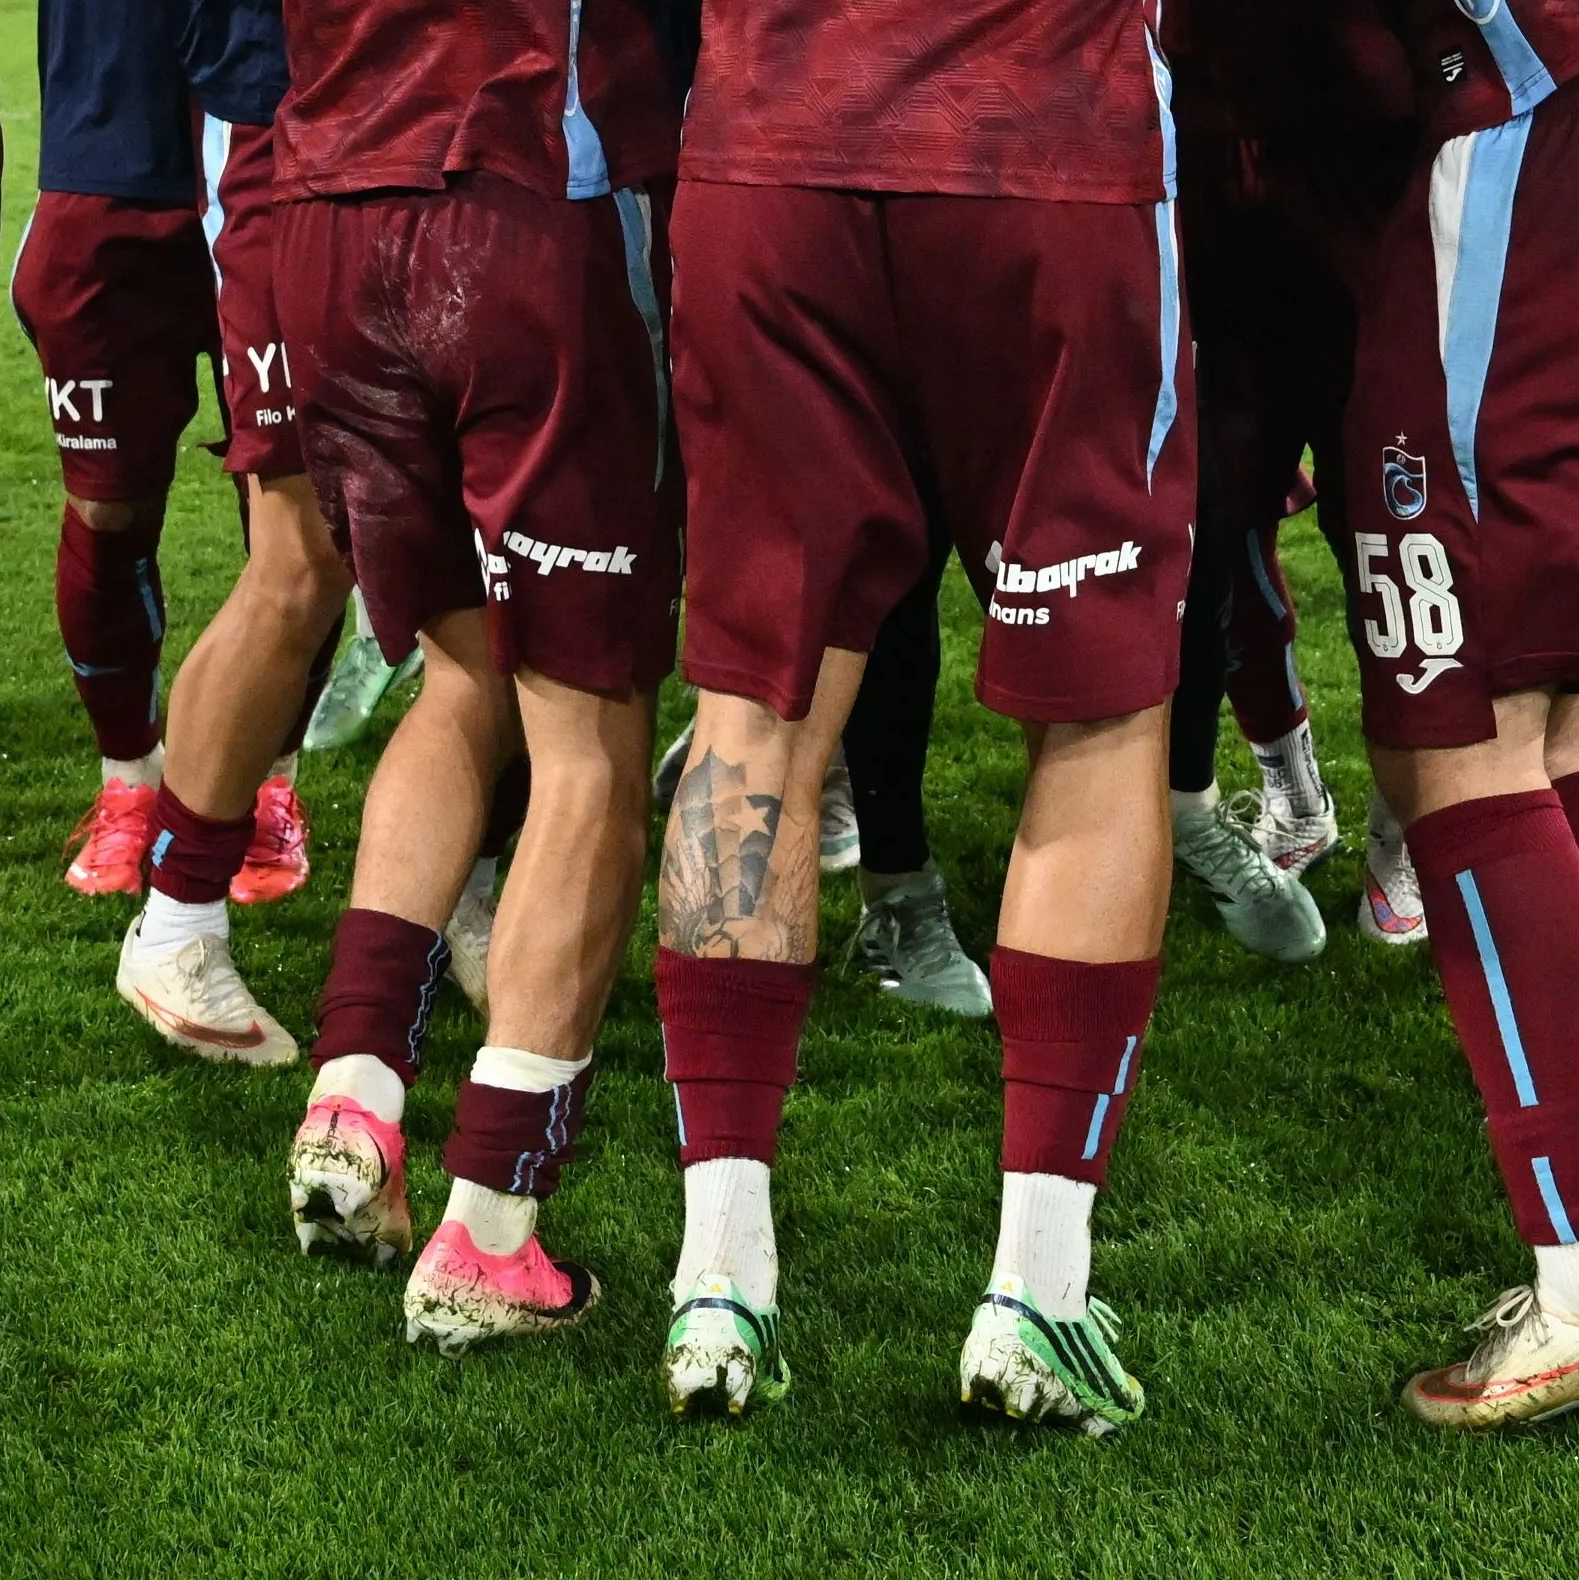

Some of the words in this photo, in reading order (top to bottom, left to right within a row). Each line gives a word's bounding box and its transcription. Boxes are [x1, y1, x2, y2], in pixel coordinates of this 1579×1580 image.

[45, 376, 113, 423] KT
[989, 594, 1050, 625] nans
[1354, 531, 1465, 659] 58
